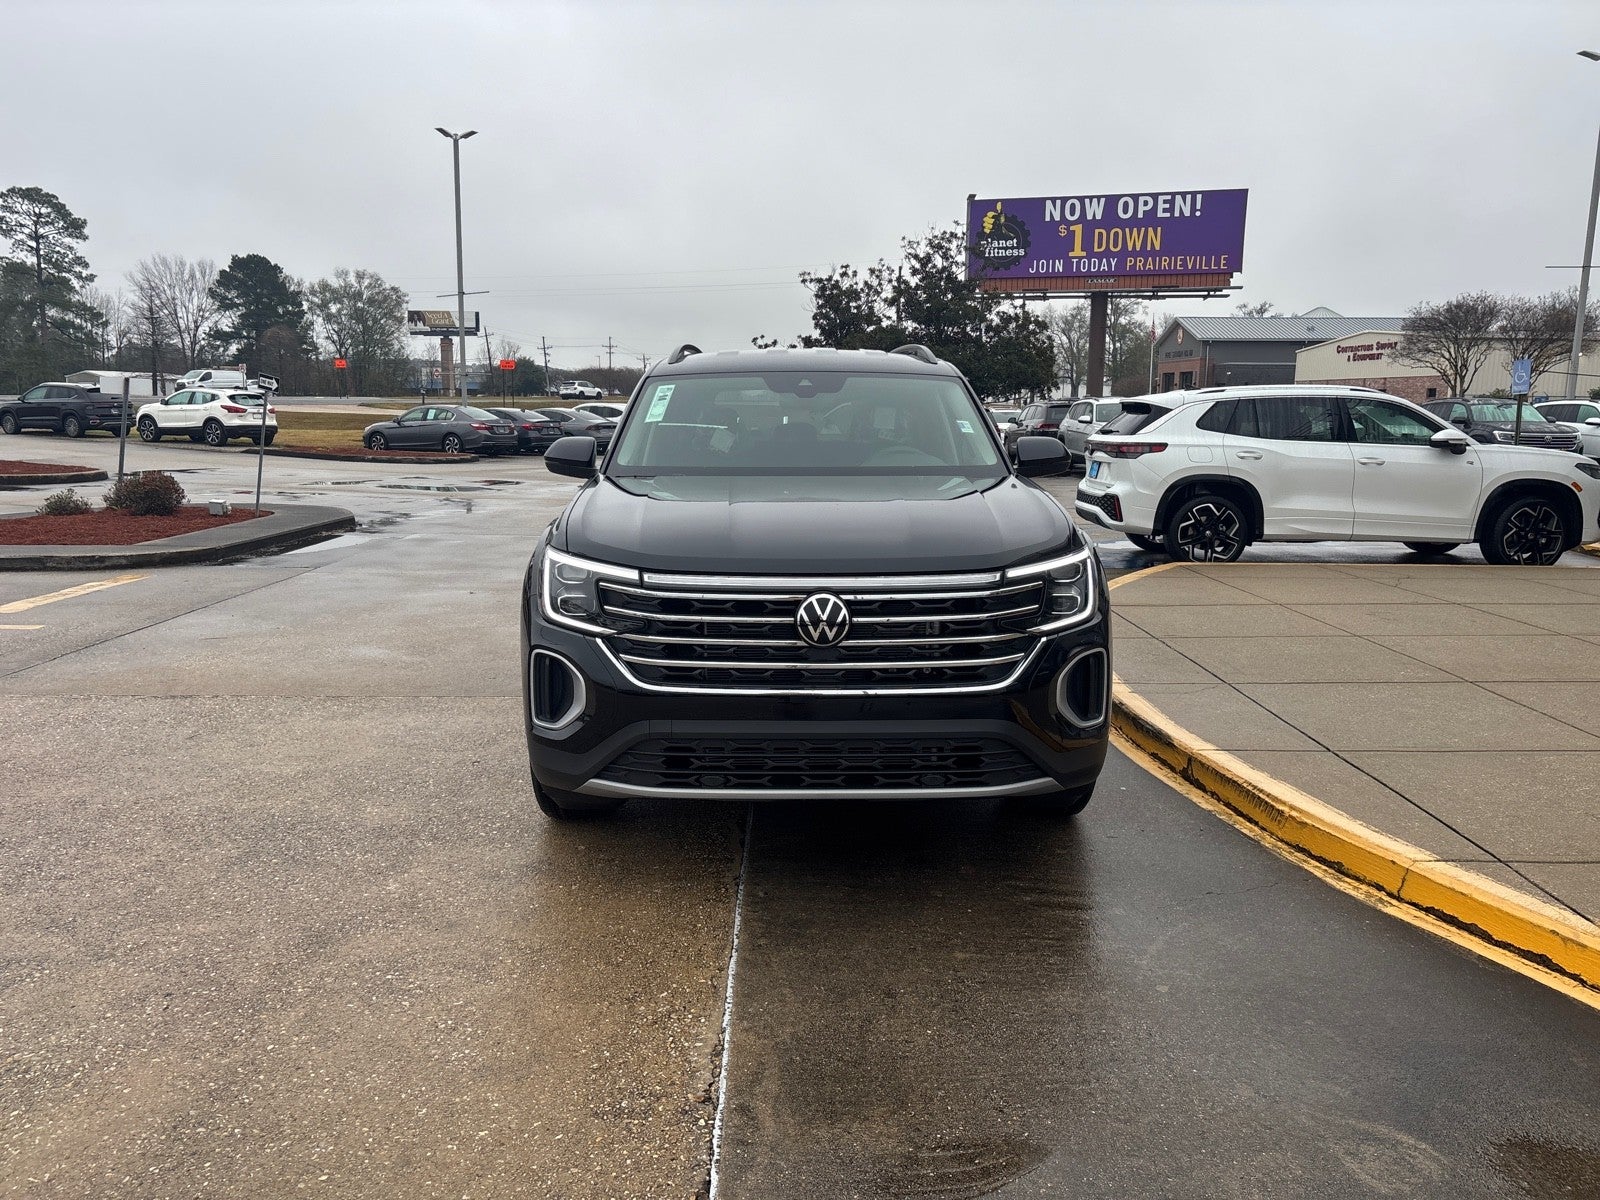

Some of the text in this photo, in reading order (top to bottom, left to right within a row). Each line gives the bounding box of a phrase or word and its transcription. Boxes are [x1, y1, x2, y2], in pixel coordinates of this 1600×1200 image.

[1044, 194, 1203, 221] NOW OPEN!
[1094, 226, 1162, 252] DOWN
[984, 247, 1025, 257] fitness
[1029, 255, 1229, 274] JOIN TODAY PRAIRIEVILLE
